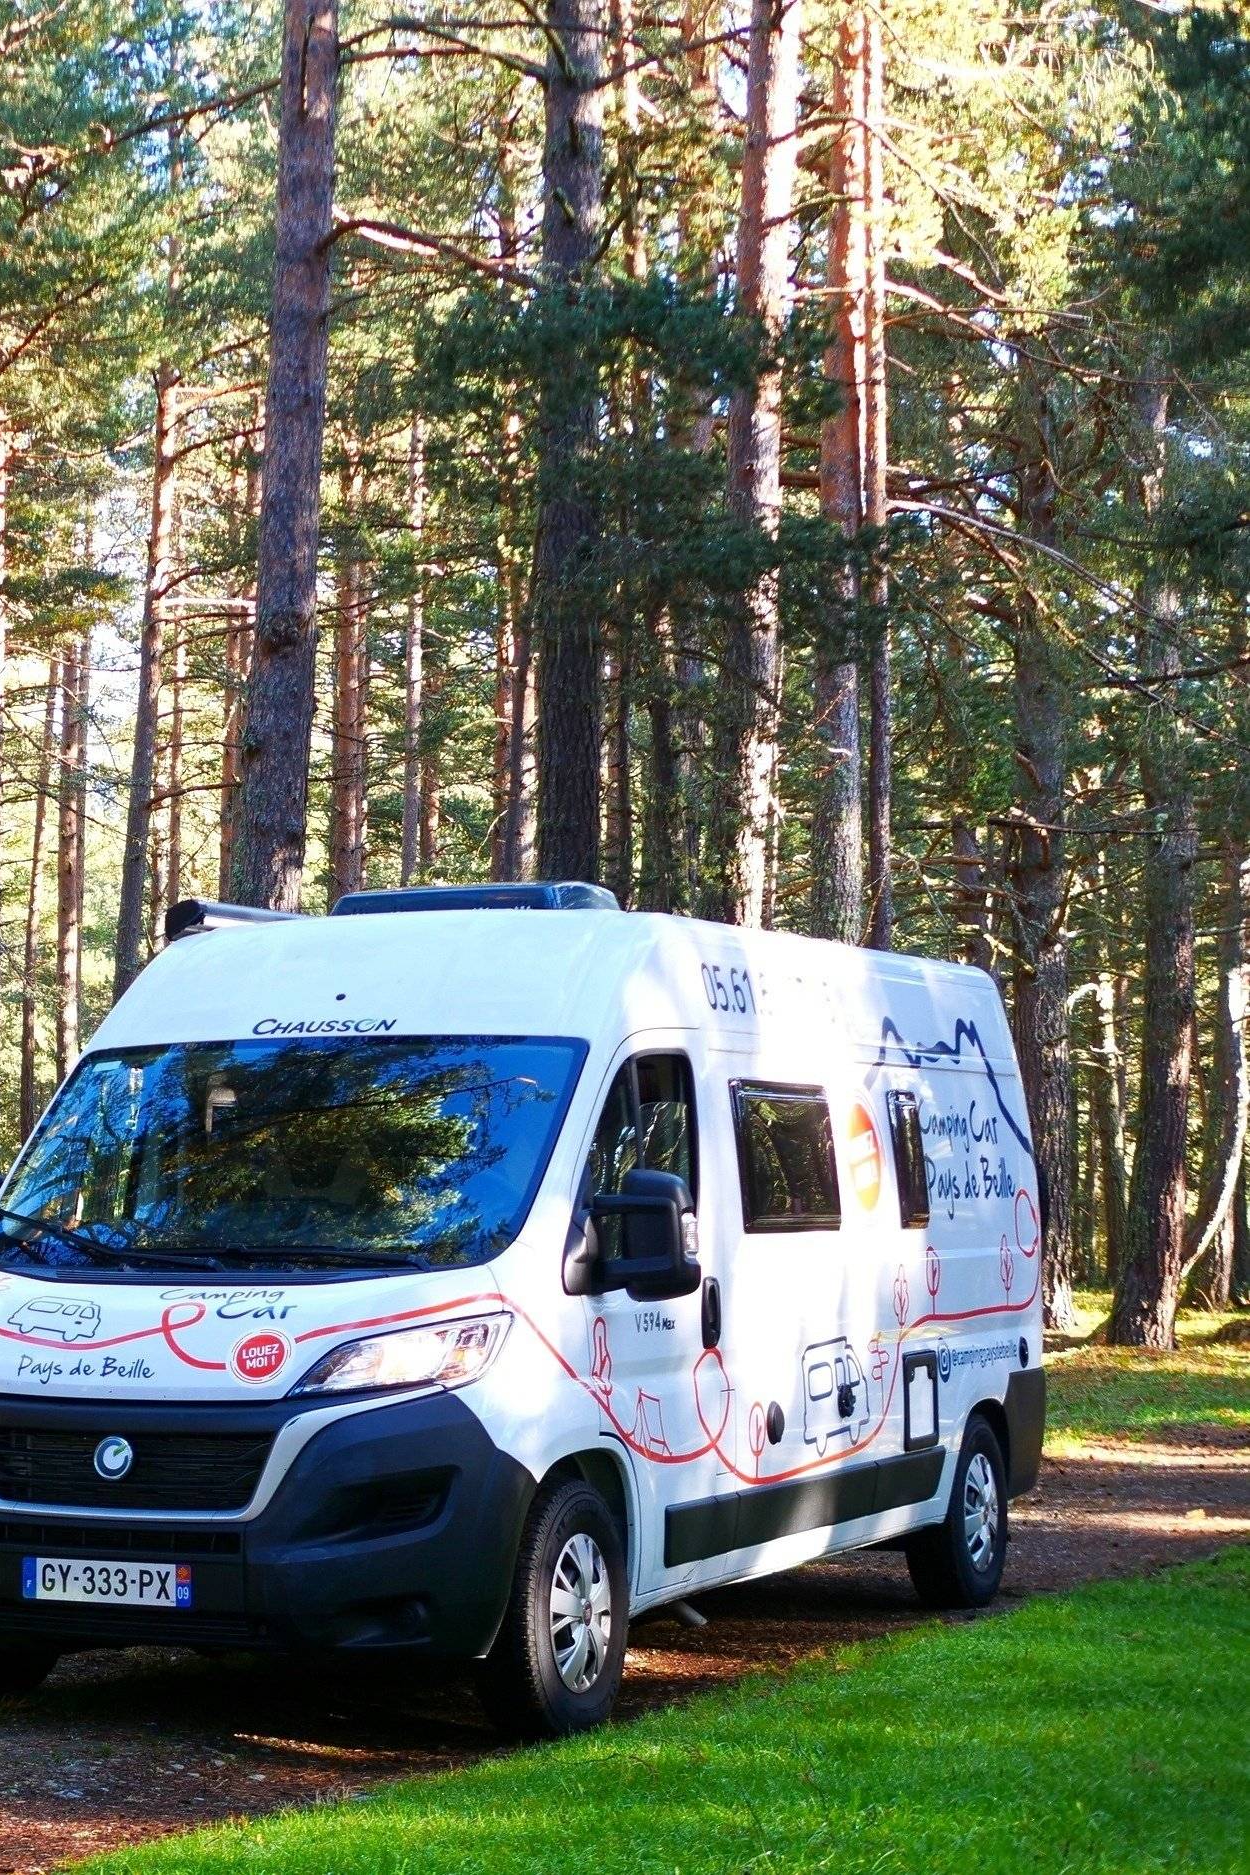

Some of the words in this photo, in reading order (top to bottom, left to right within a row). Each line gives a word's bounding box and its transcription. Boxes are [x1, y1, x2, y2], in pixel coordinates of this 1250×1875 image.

[252, 1018, 398, 1035] CHAUSSON
[969, 1100, 998, 1144] Car
[923, 1153, 961, 1220] Pays
[964, 1160, 981, 1199] de
[979, 1154, 1016, 1199] Beille
[159, 1288, 285, 1304] Camping
[216, 1299, 298, 1320] Car
[242, 1343, 280, 1358] LOUEZ
[17, 1354, 63, 1385] Pays
[69, 1358, 96, 1376] de
[99, 1356, 155, 1379] Beille
[26, 1579, 33, 1588] F
[41, 1563, 171, 1600] GY-333-PX
[177, 1586, 189, 1600] 09
